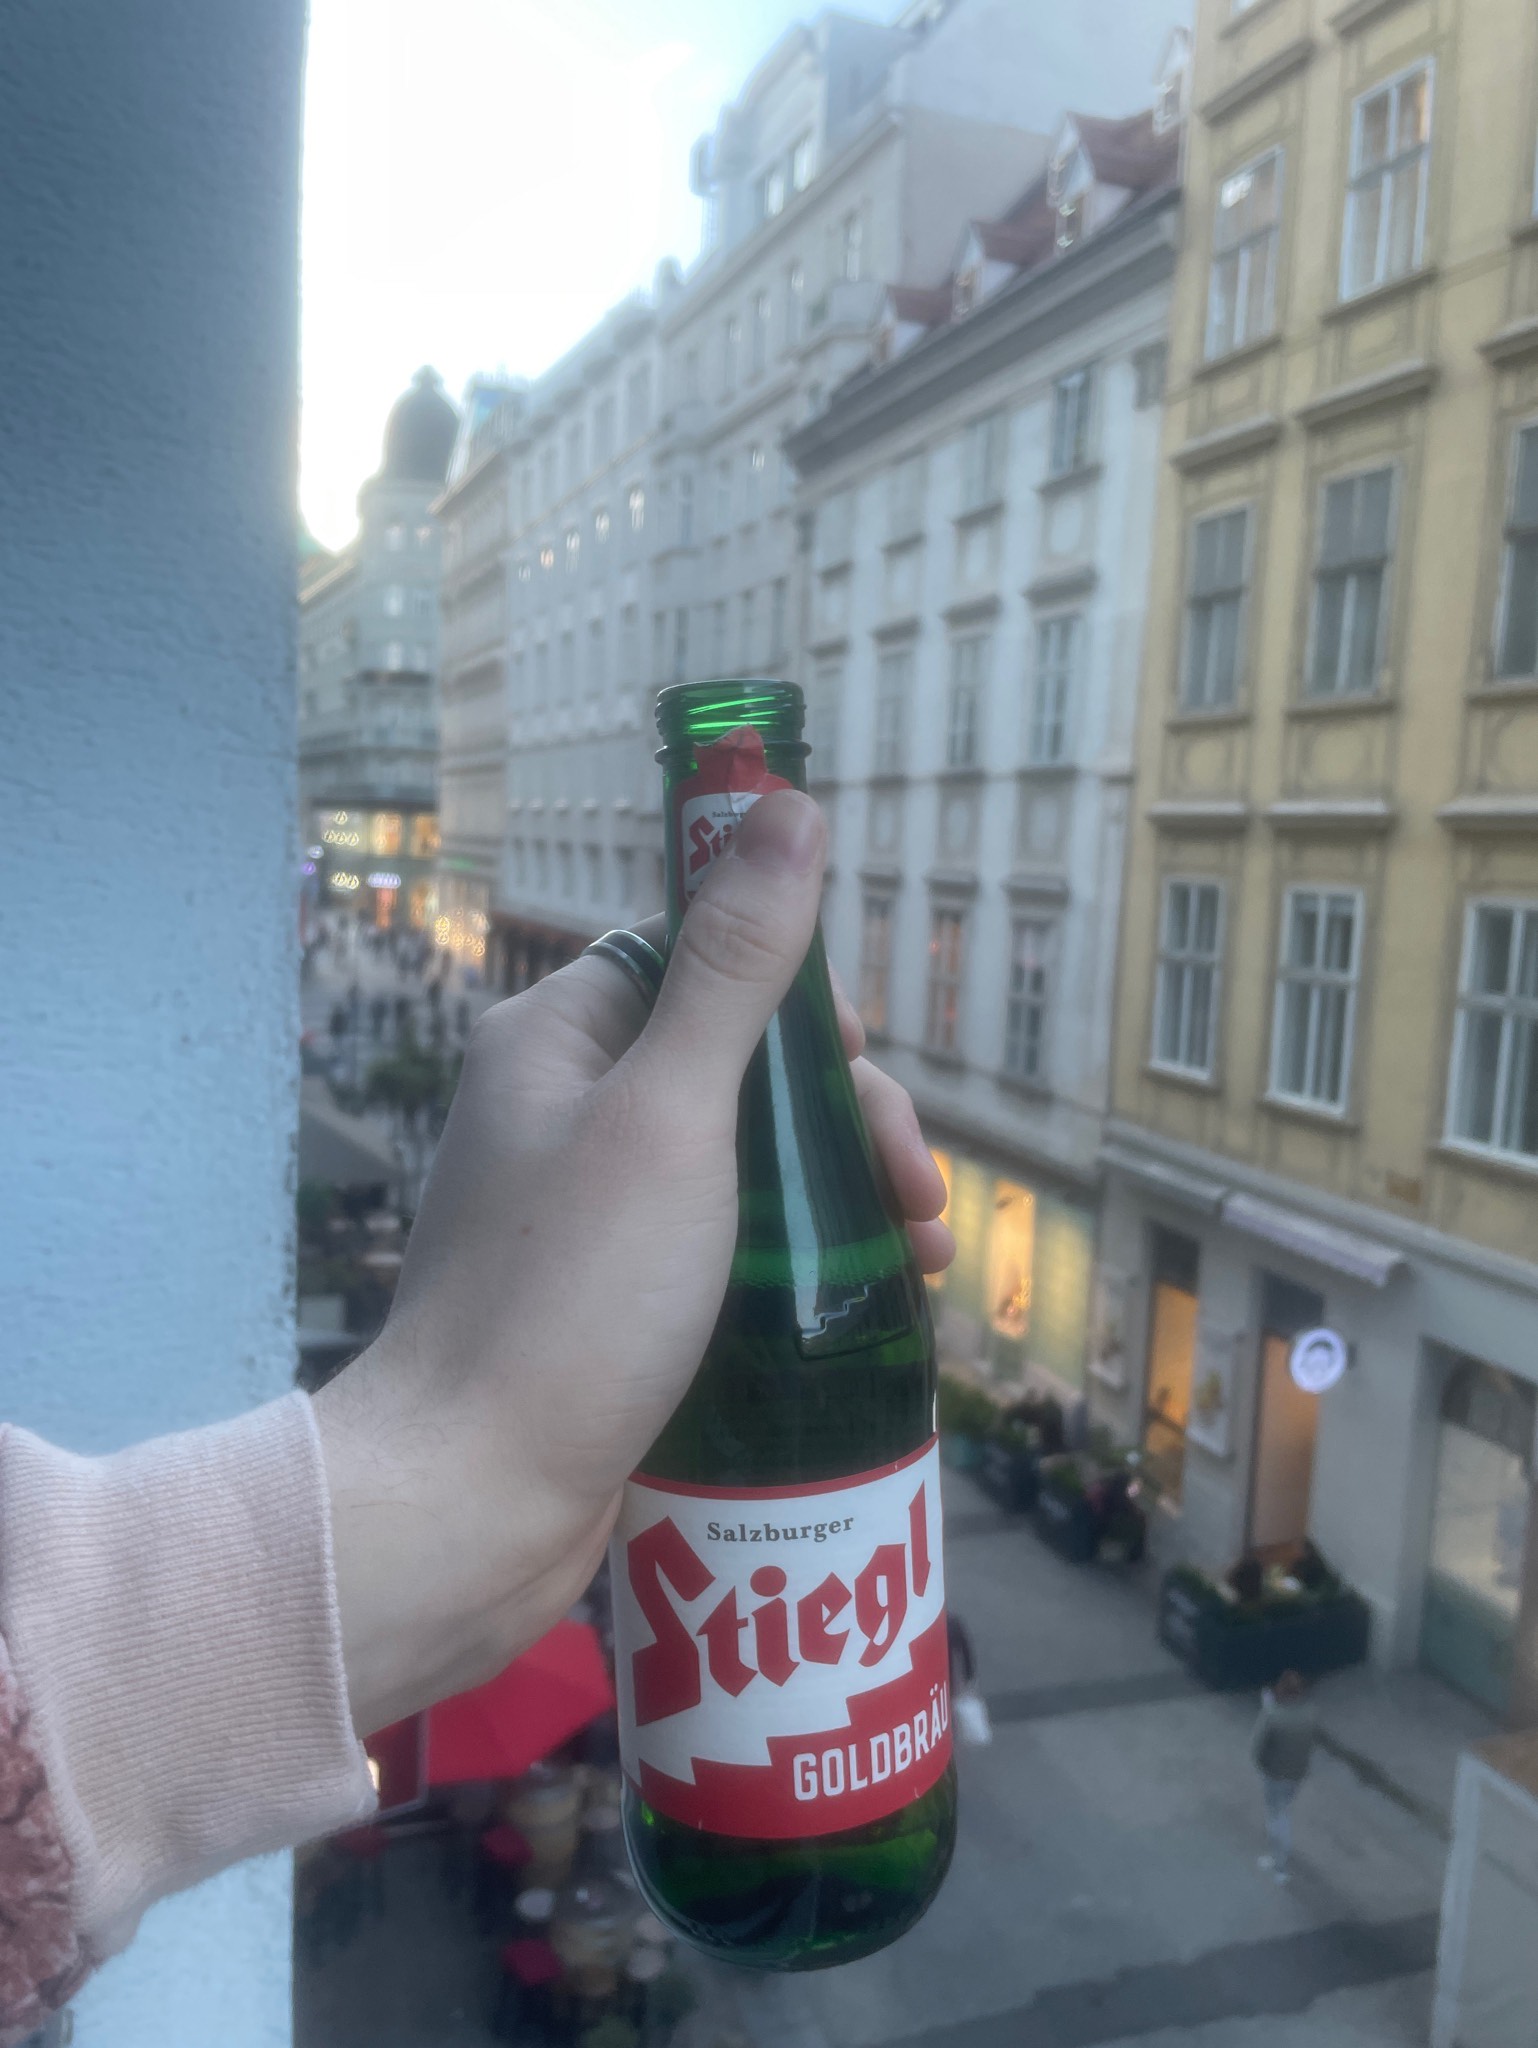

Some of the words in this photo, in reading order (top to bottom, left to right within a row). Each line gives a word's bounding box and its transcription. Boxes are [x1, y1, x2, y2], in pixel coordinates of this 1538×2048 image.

[707, 1516, 855, 1543] Salzburger
[627, 1480, 932, 1728] Stiegl
[792, 1680, 948, 1801] GOLDBRÄU
